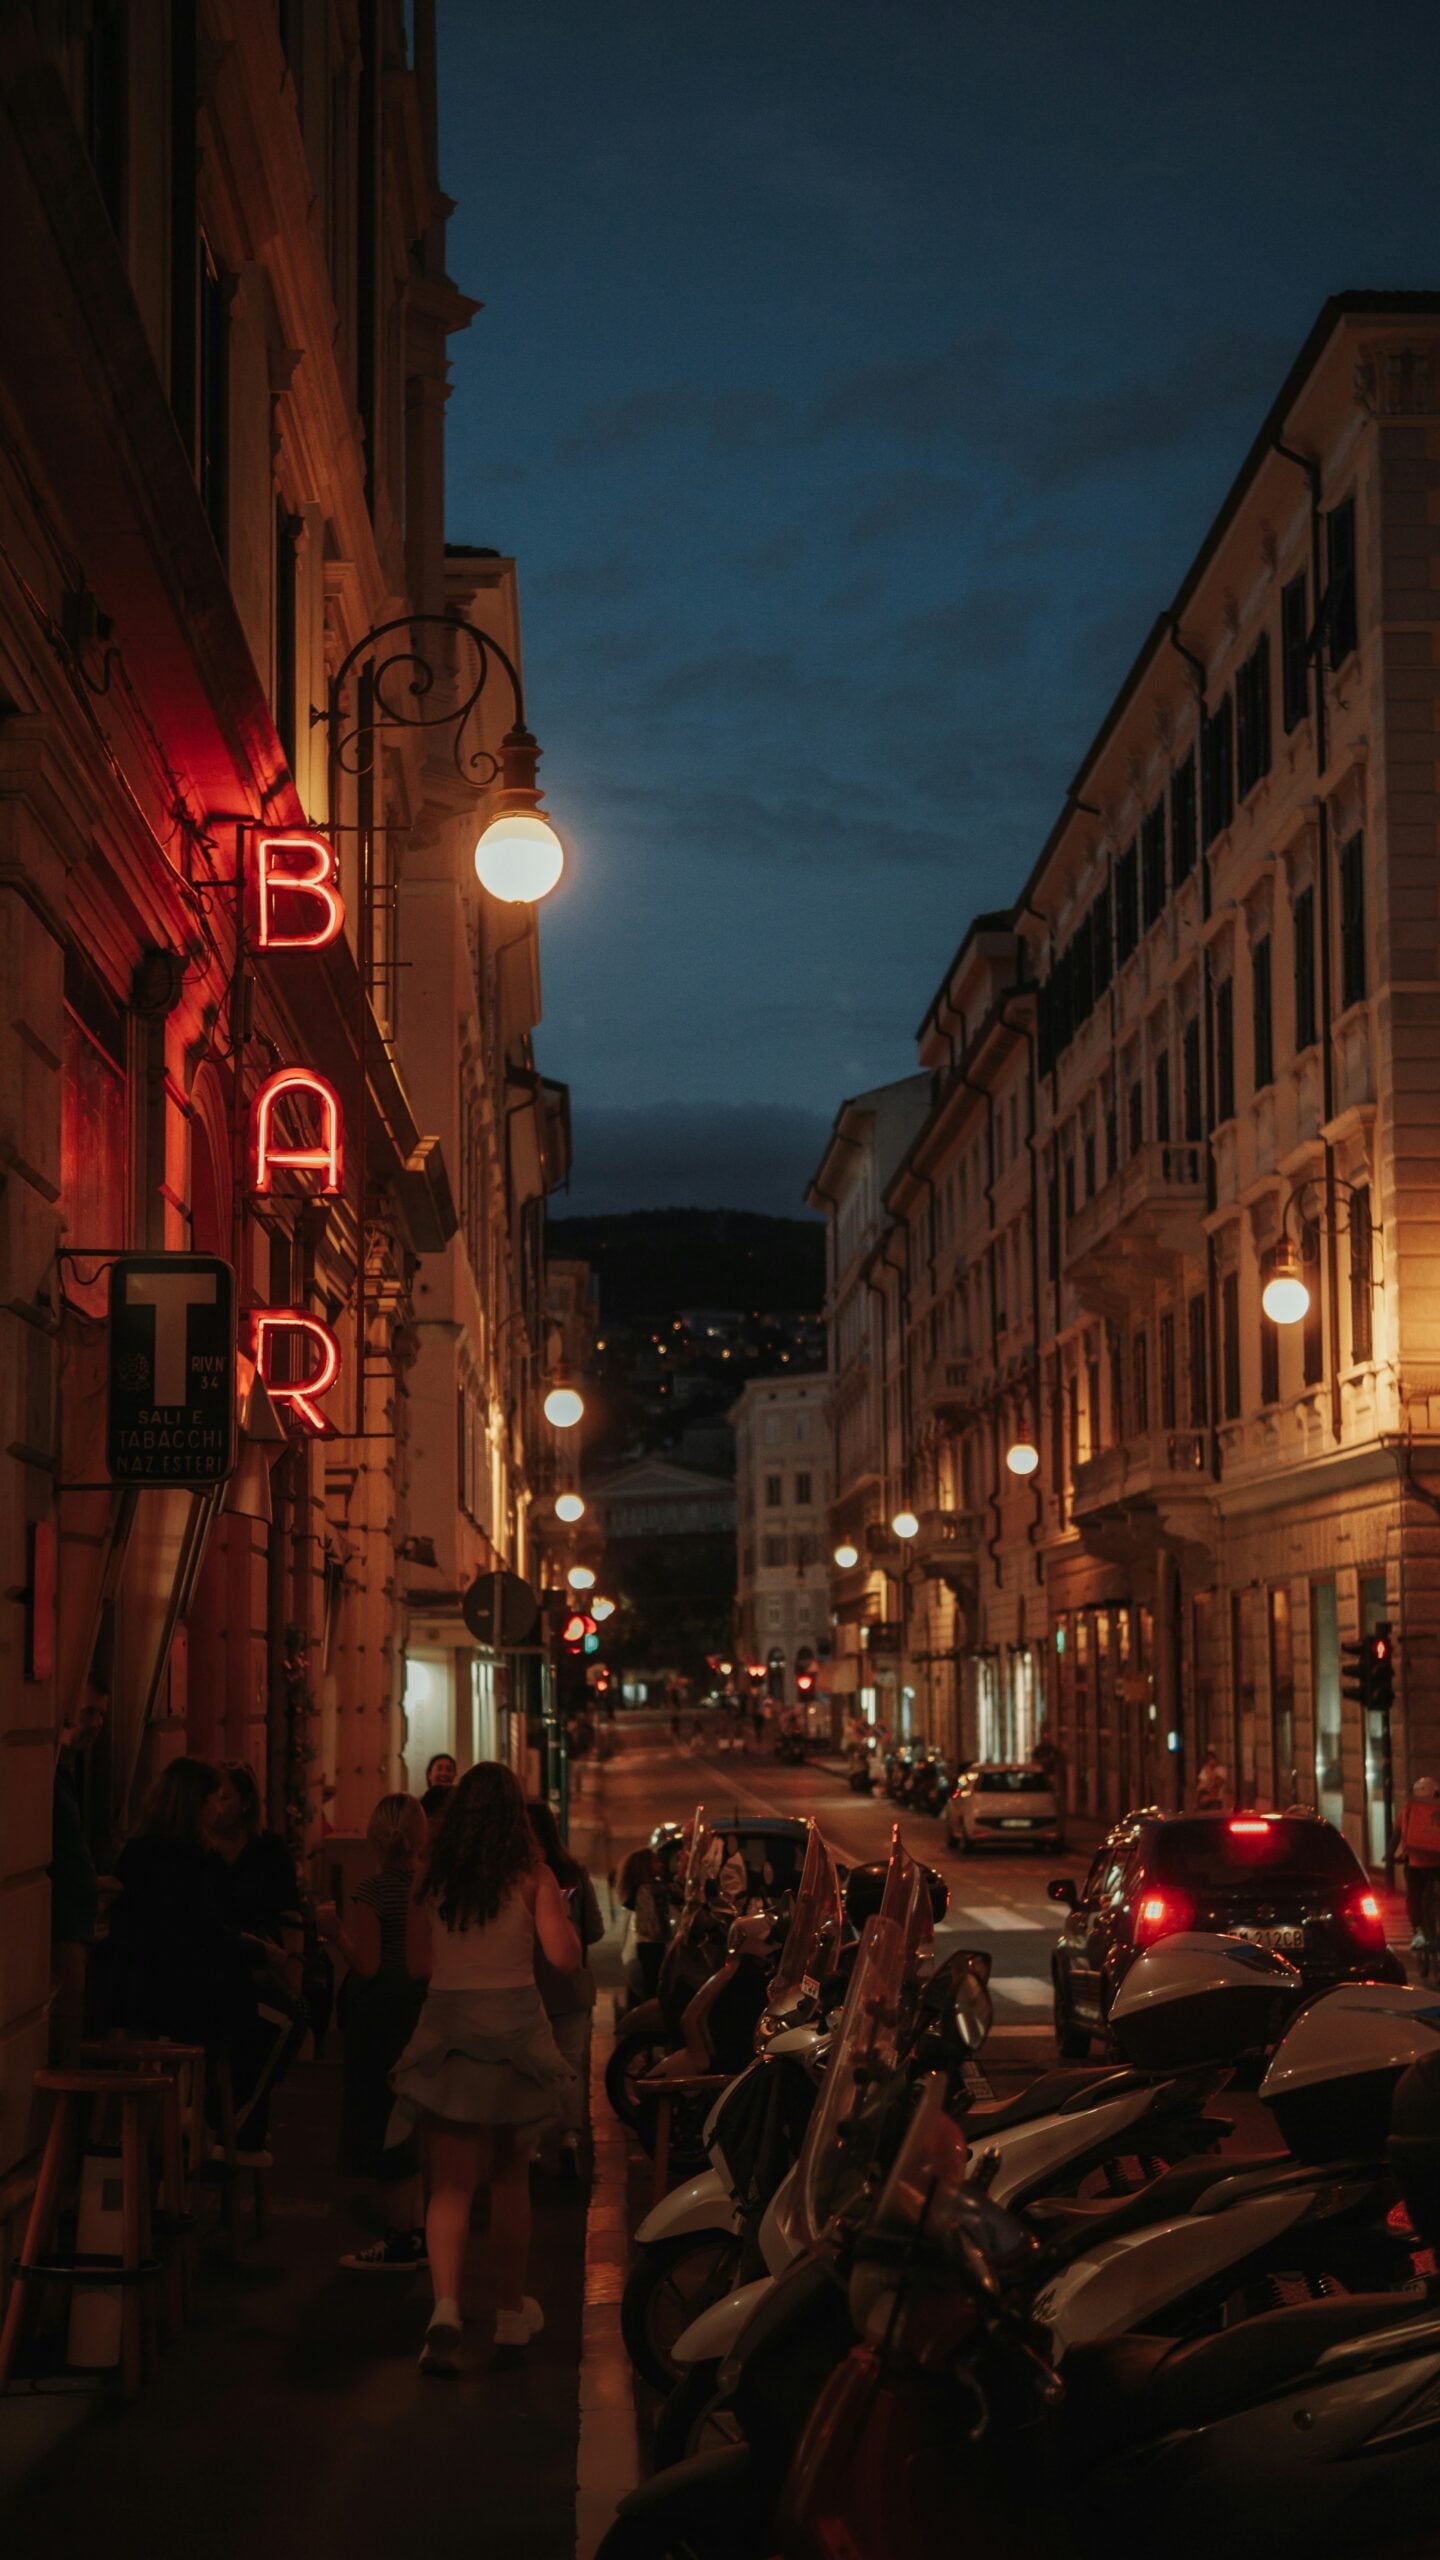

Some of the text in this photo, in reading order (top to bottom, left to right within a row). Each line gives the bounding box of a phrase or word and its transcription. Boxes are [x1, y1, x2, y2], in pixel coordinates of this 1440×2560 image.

[250, 828, 344, 1436] BAR
[125, 1272, 217, 1406] T
[200, 1375, 219, 1390] 34
[137, 1410, 203, 1425] SALI E
[117, 1429, 223, 1449] TABACCHI
